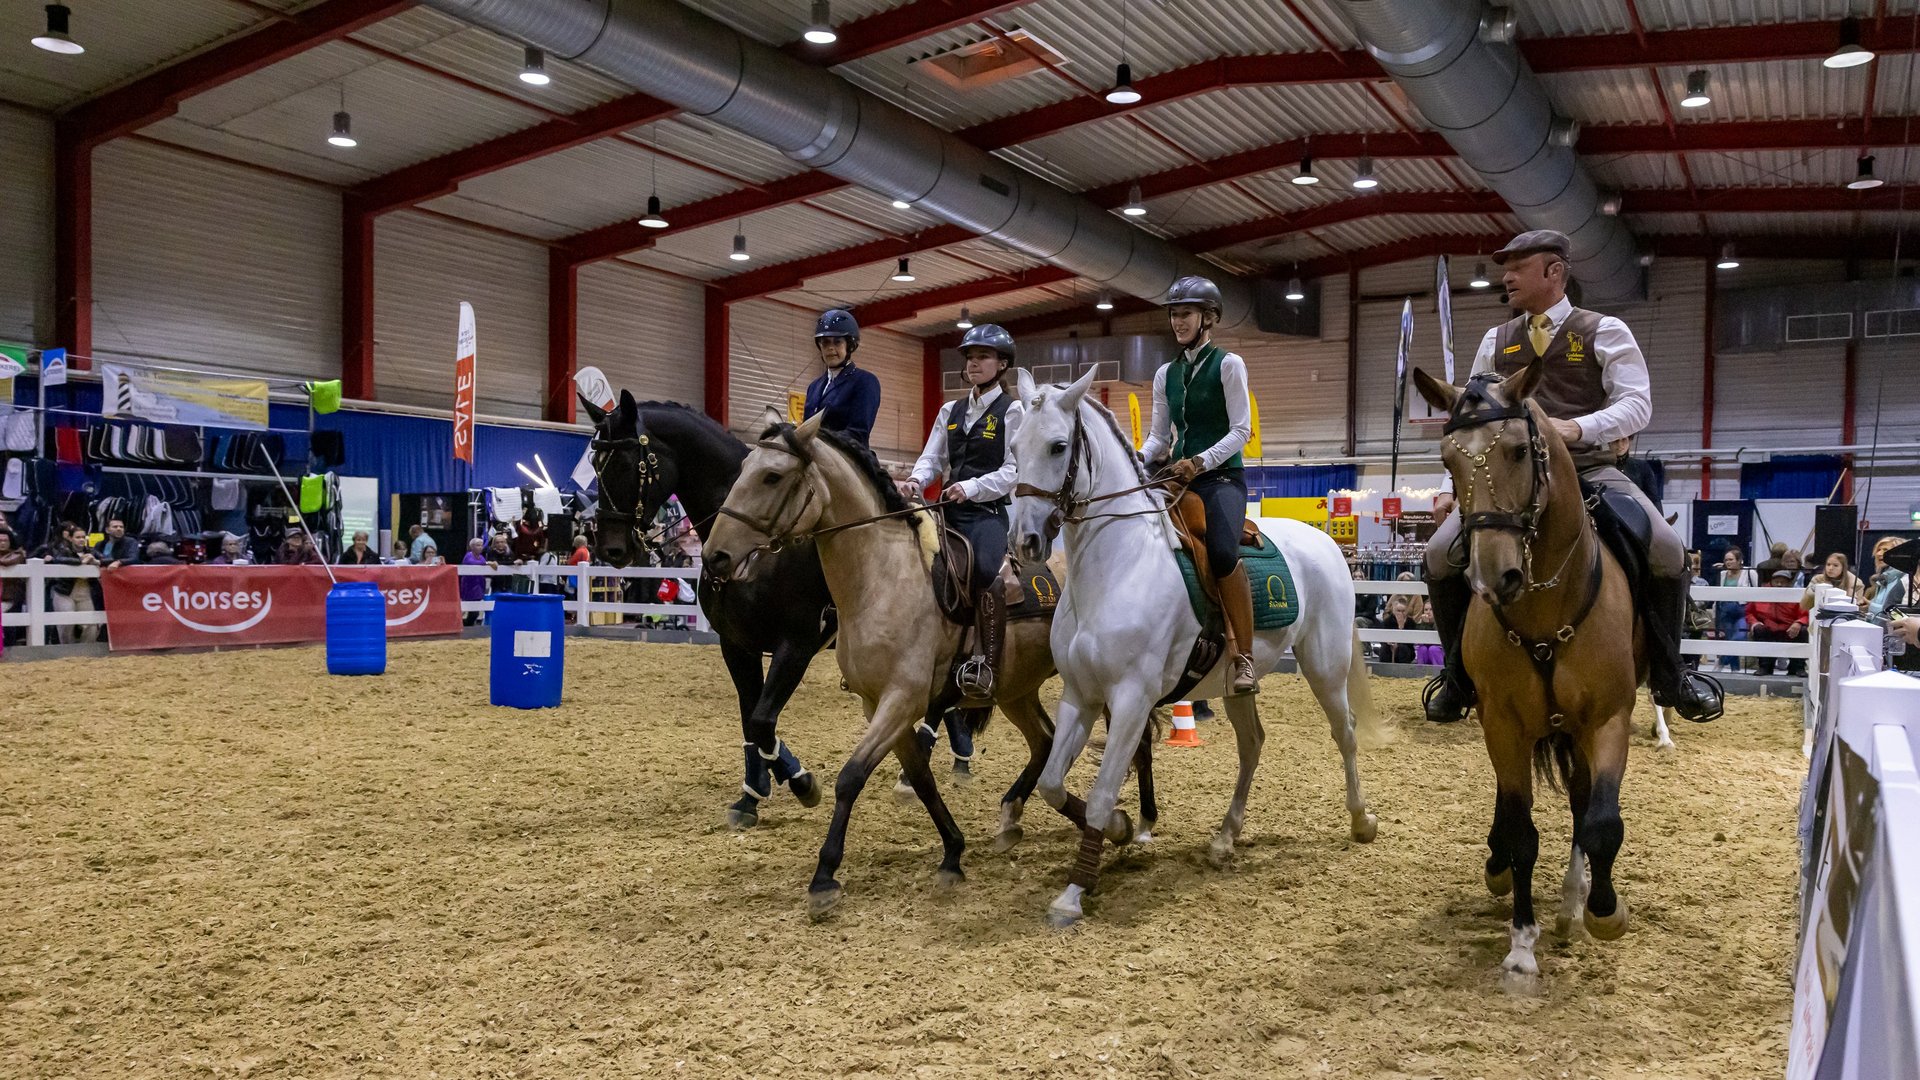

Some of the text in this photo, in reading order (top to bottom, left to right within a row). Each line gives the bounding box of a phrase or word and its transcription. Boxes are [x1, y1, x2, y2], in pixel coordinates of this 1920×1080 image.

[666, 507, 679, 517] KL
[142, 585, 262, 612] e horses
[380, 588, 423, 605] ses
